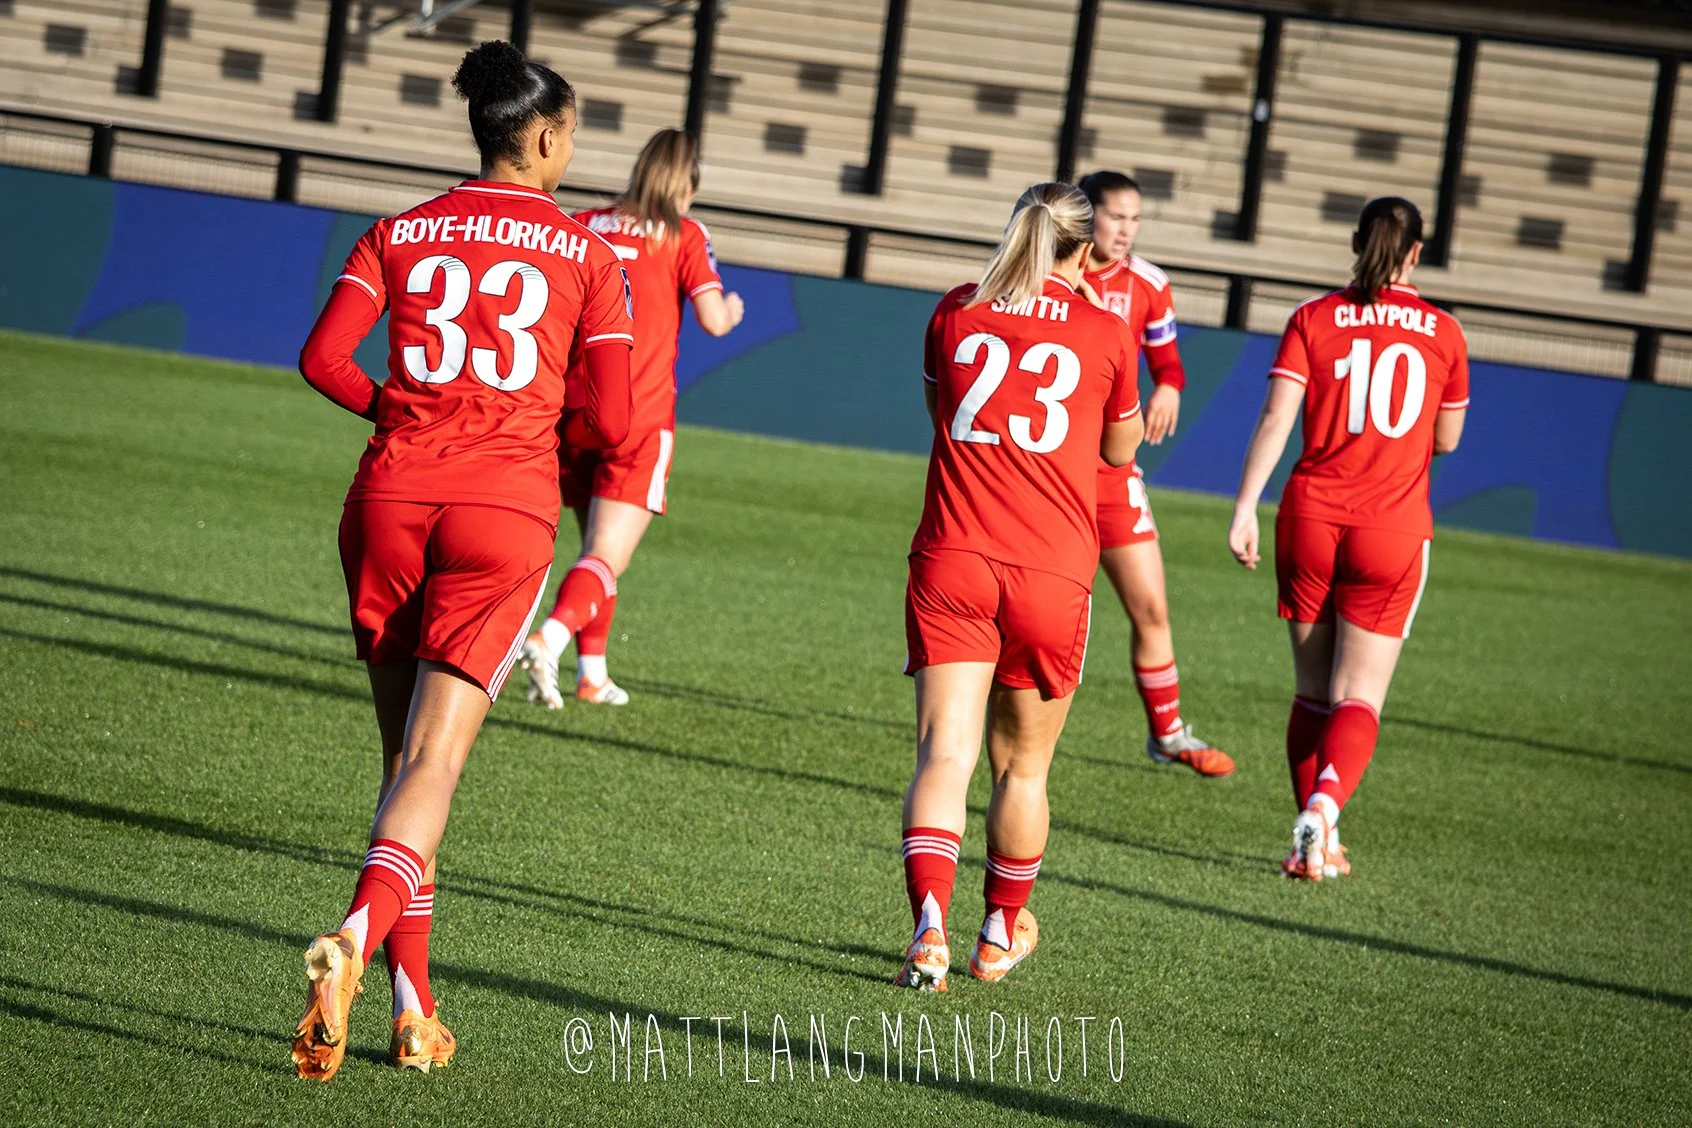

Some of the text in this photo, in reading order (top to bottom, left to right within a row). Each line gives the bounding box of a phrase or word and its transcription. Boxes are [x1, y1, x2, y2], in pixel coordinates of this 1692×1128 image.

[390, 215, 589, 264] BOYE-HLORKAH
[402, 254, 550, 393] 33
[1334, 303, 1438, 337] CLAYPOLE
[950, 332, 1082, 454] 23
[1333, 337, 1427, 439] 10
